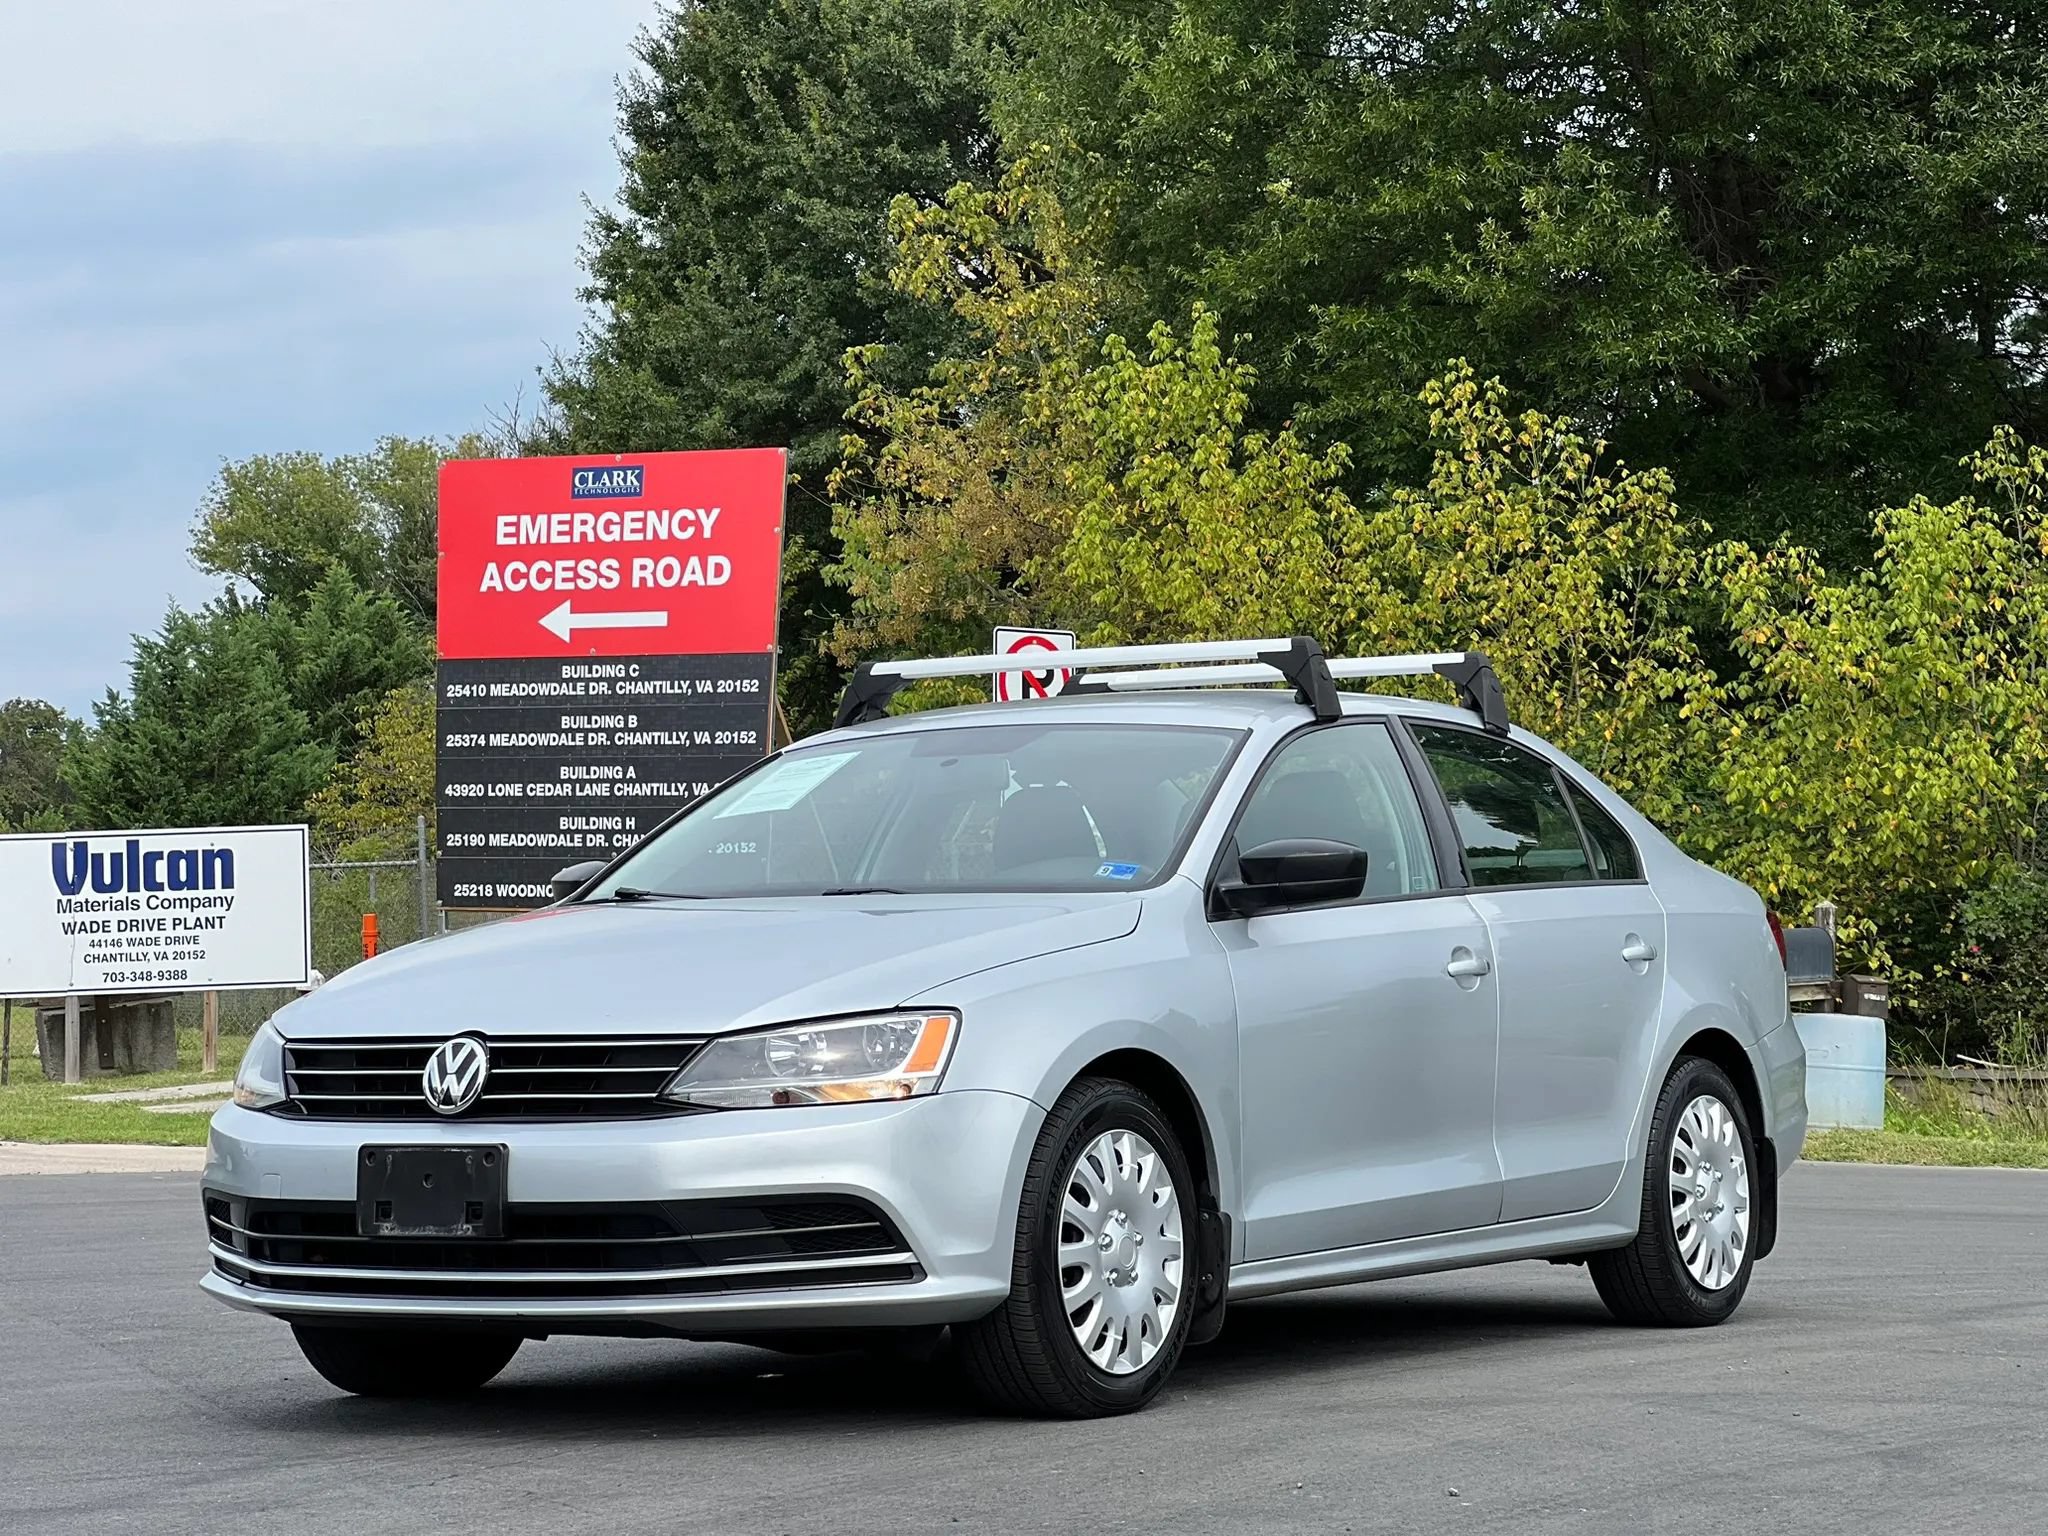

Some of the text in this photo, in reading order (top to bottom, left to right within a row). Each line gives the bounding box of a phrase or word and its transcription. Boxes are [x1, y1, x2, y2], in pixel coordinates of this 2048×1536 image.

[574, 469, 641, 488] CLARK
[574, 486, 641, 495] TECHNOLOGIES
[496, 507, 721, 546] EMERGENCY
[479, 555, 732, 593] ACCESS ROAD
[561, 663, 640, 679] BUILDING C
[446, 679, 760, 698] 25410 MEADOWDALE DR. CHANTILLY, VA 20152
[561, 714, 638, 729] BUILDING B
[445, 730, 757, 748] 25374 MEADOWDALE DR. CHANTILLY, VA 20152
[560, 765, 637, 780] BUILDING A
[444, 783, 485, 797] 43920
[487, 783, 524, 797] LONE
[526, 783, 573, 797] CEDAR
[575, 782, 611, 797] LANE
[613, 782, 689, 799] CHANTILLY,
[692, 782, 710, 796] VA
[559, 816, 636, 830] BUILDING H
[446, 833, 486, 847] 25190
[488, 833, 583, 847] MEADOWDALE
[586, 833, 610, 847] DR.
[716, 842, 757, 854] 20152
[51, 839, 235, 896] Vulcan
[453, 883, 493, 897] 25218
[56, 895, 235, 914] Materials Company
[61, 916, 227, 936] WADE DRIVE PLANT
[88, 935, 200, 949] 44146 WADE DRIVE
[83, 950, 206, 964] CHANTILLY, VA 20152
[102, 969, 188, 983] 703-348-9388
